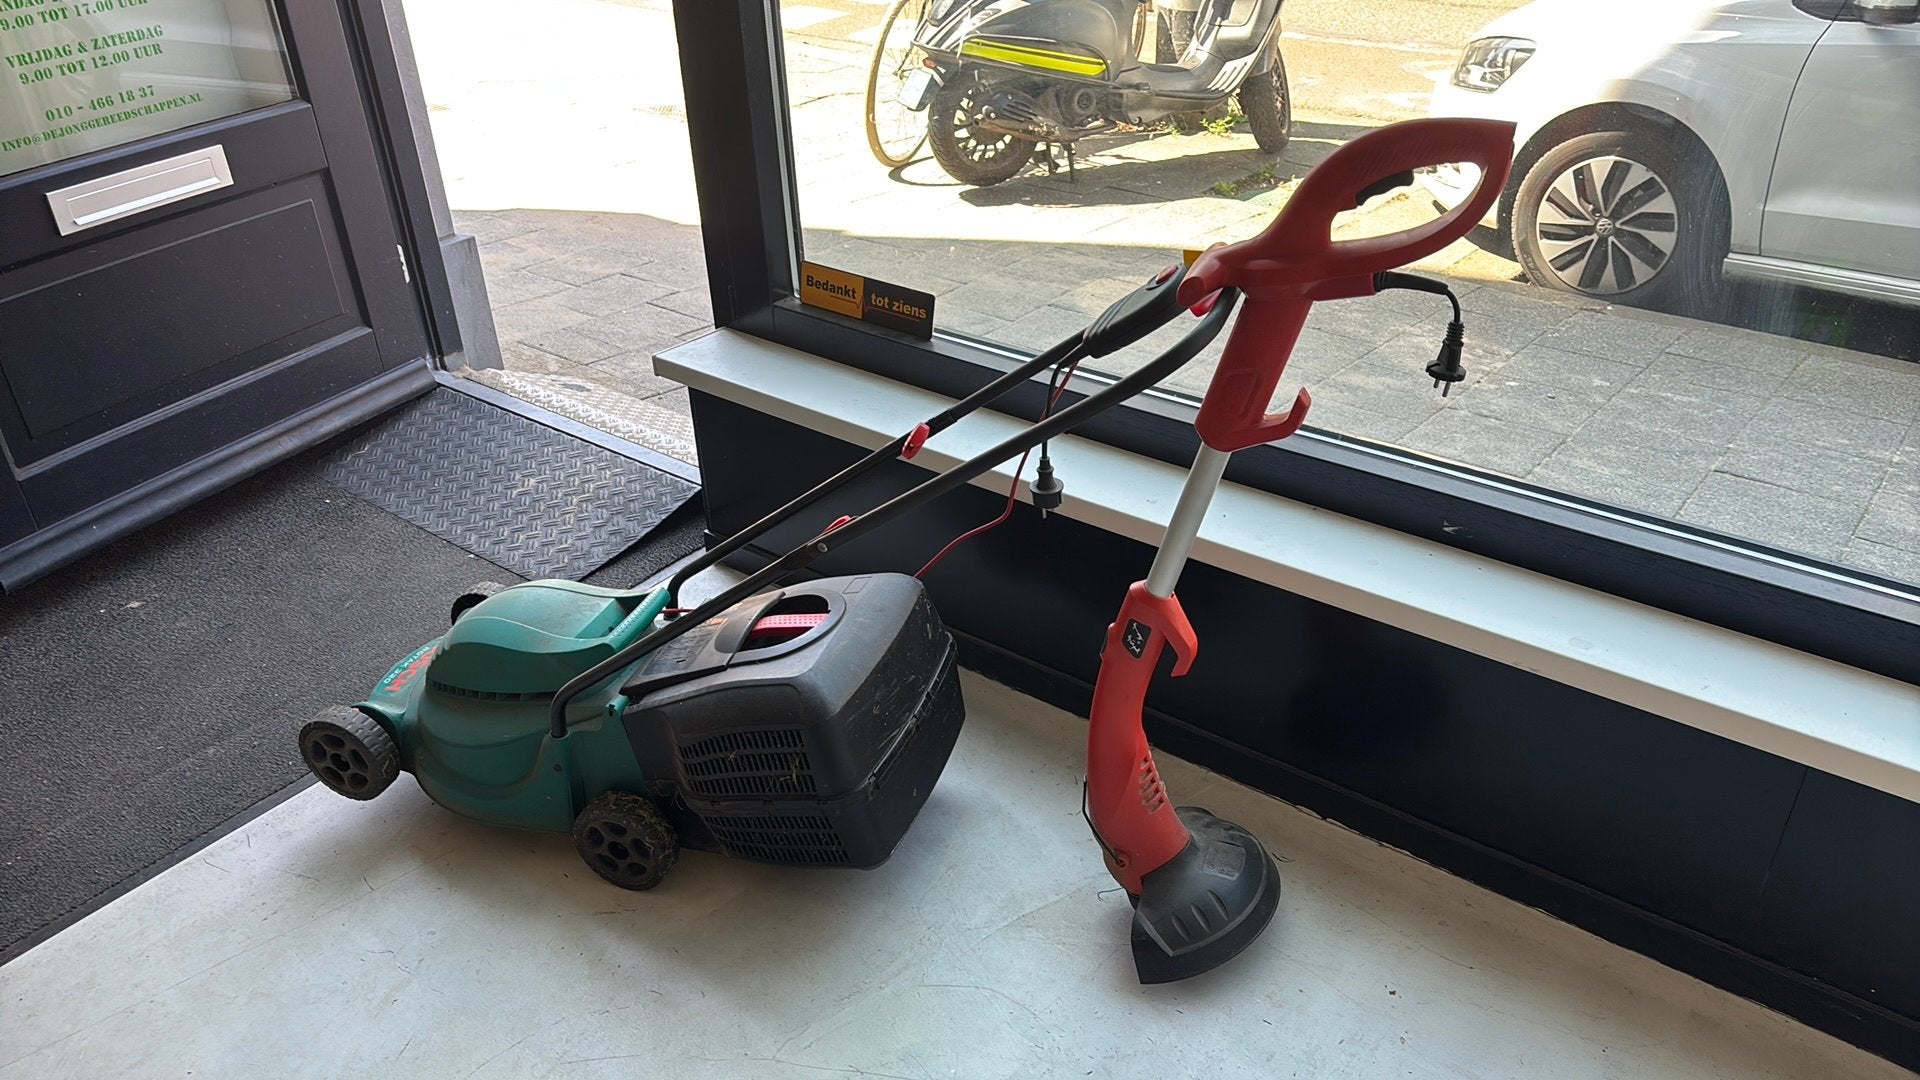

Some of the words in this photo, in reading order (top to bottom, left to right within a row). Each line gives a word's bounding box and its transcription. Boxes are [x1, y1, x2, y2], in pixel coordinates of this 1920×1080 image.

[0, 14, 34, 31] 9.00
[37, 7, 68, 23] TOT
[74, 0, 113, 16] 17.00
[5, 44, 72, 68] VRIJDAG
[77, 41, 88, 54] &
[91, 25, 163, 50] ZATERDAG
[19, 67, 53, 85] 9.00
[56, 60, 86, 77] TOT
[91, 50, 130, 69] 12.00
[133, 43, 163, 60] UUR
[45, 105, 73, 121] 010
[88, 95, 114, 111] 466
[119, 91, 135, 104] 18
[140, 85, 155, 98] 37
[806, 275, 857, 300] Bedankt
[871, 293, 889, 309] tot
[893, 300, 927, 319] ziens
[383, 669, 402, 684] 320
